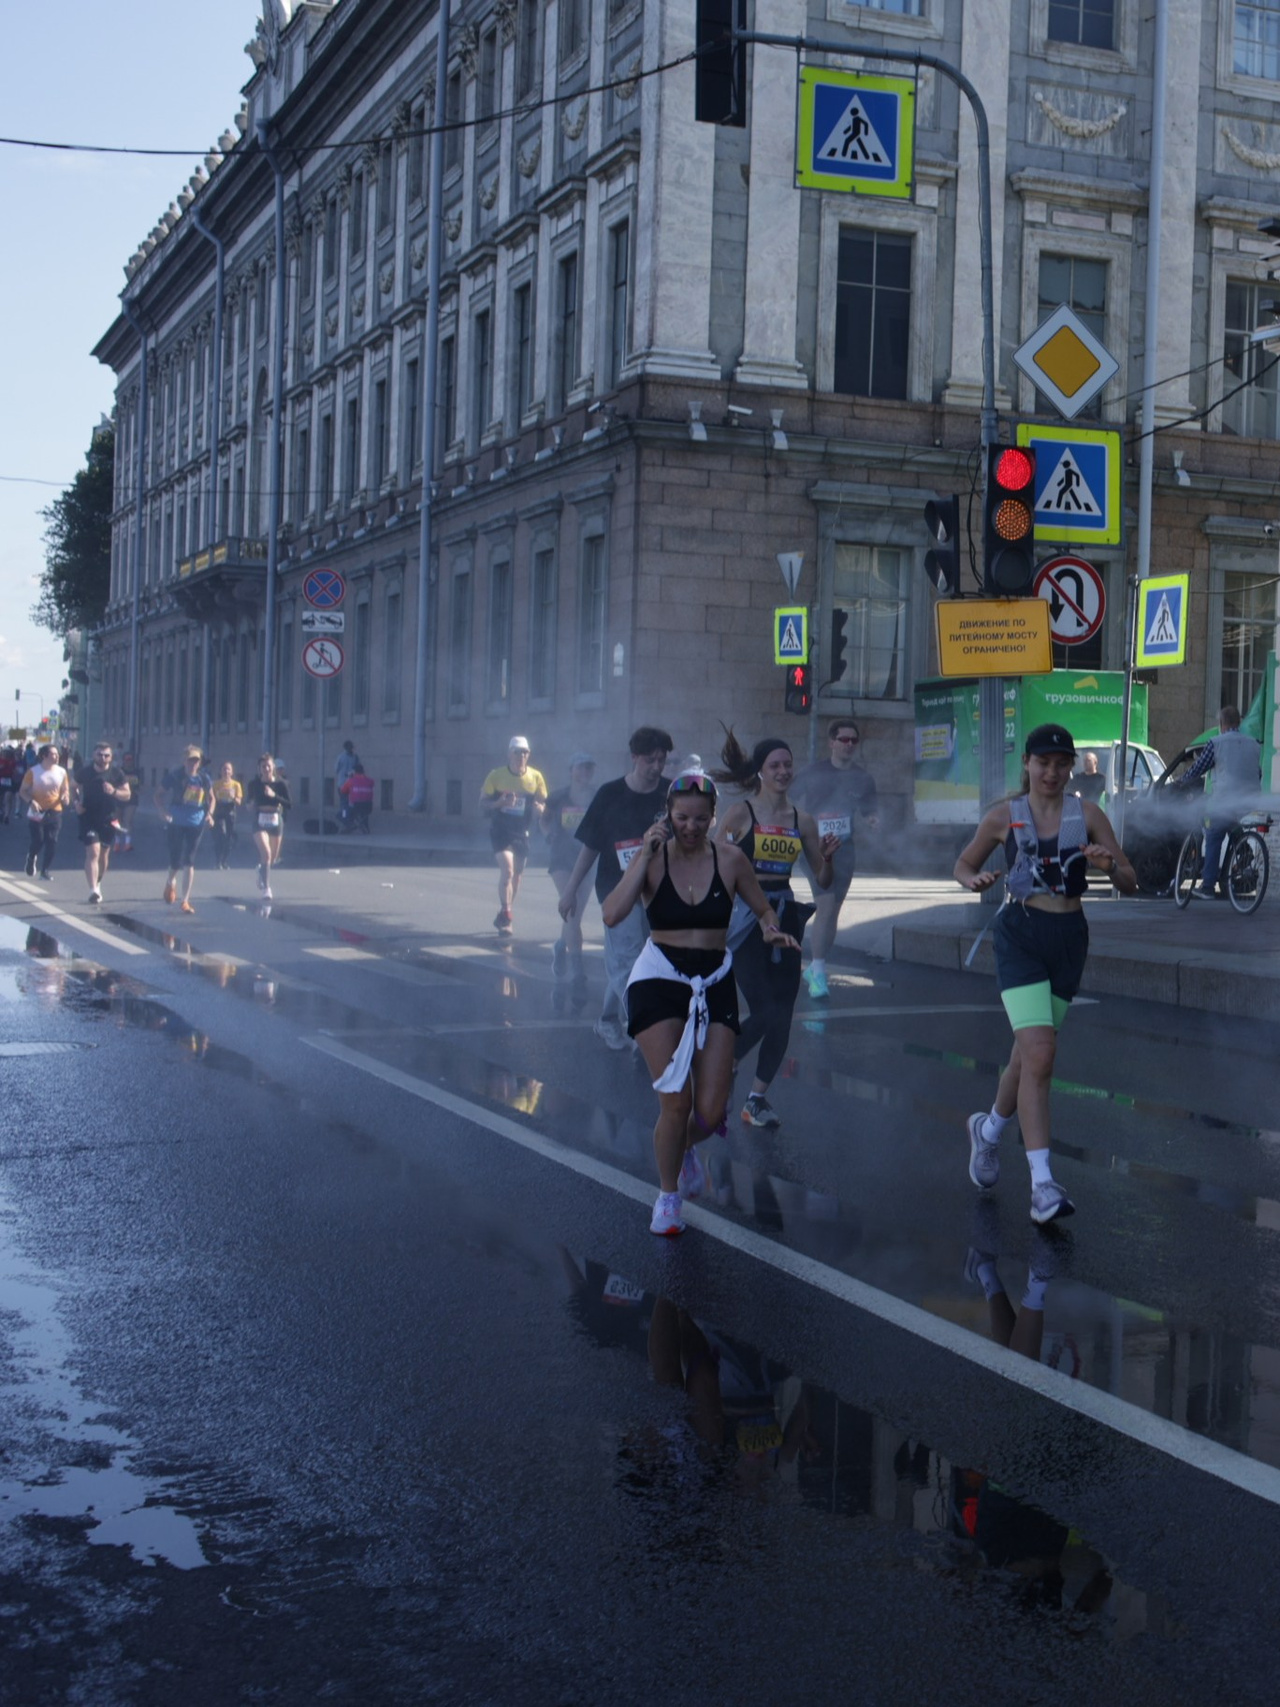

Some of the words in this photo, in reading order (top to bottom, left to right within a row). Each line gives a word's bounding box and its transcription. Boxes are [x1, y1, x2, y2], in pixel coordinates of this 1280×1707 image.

[959, 620, 1010, 629] ДВИЖЕНИЕ
[1012, 619, 1026, 627] ПО
[949, 631, 1005, 642] ЛИТЕЙНОМУ
[1007, 631, 1038, 640] МОСТУ
[962, 644, 1027, 655] ОГРАНИЧЕНО!
[822, 820, 847, 832] 2024
[761, 838, 796, 855] 6006
